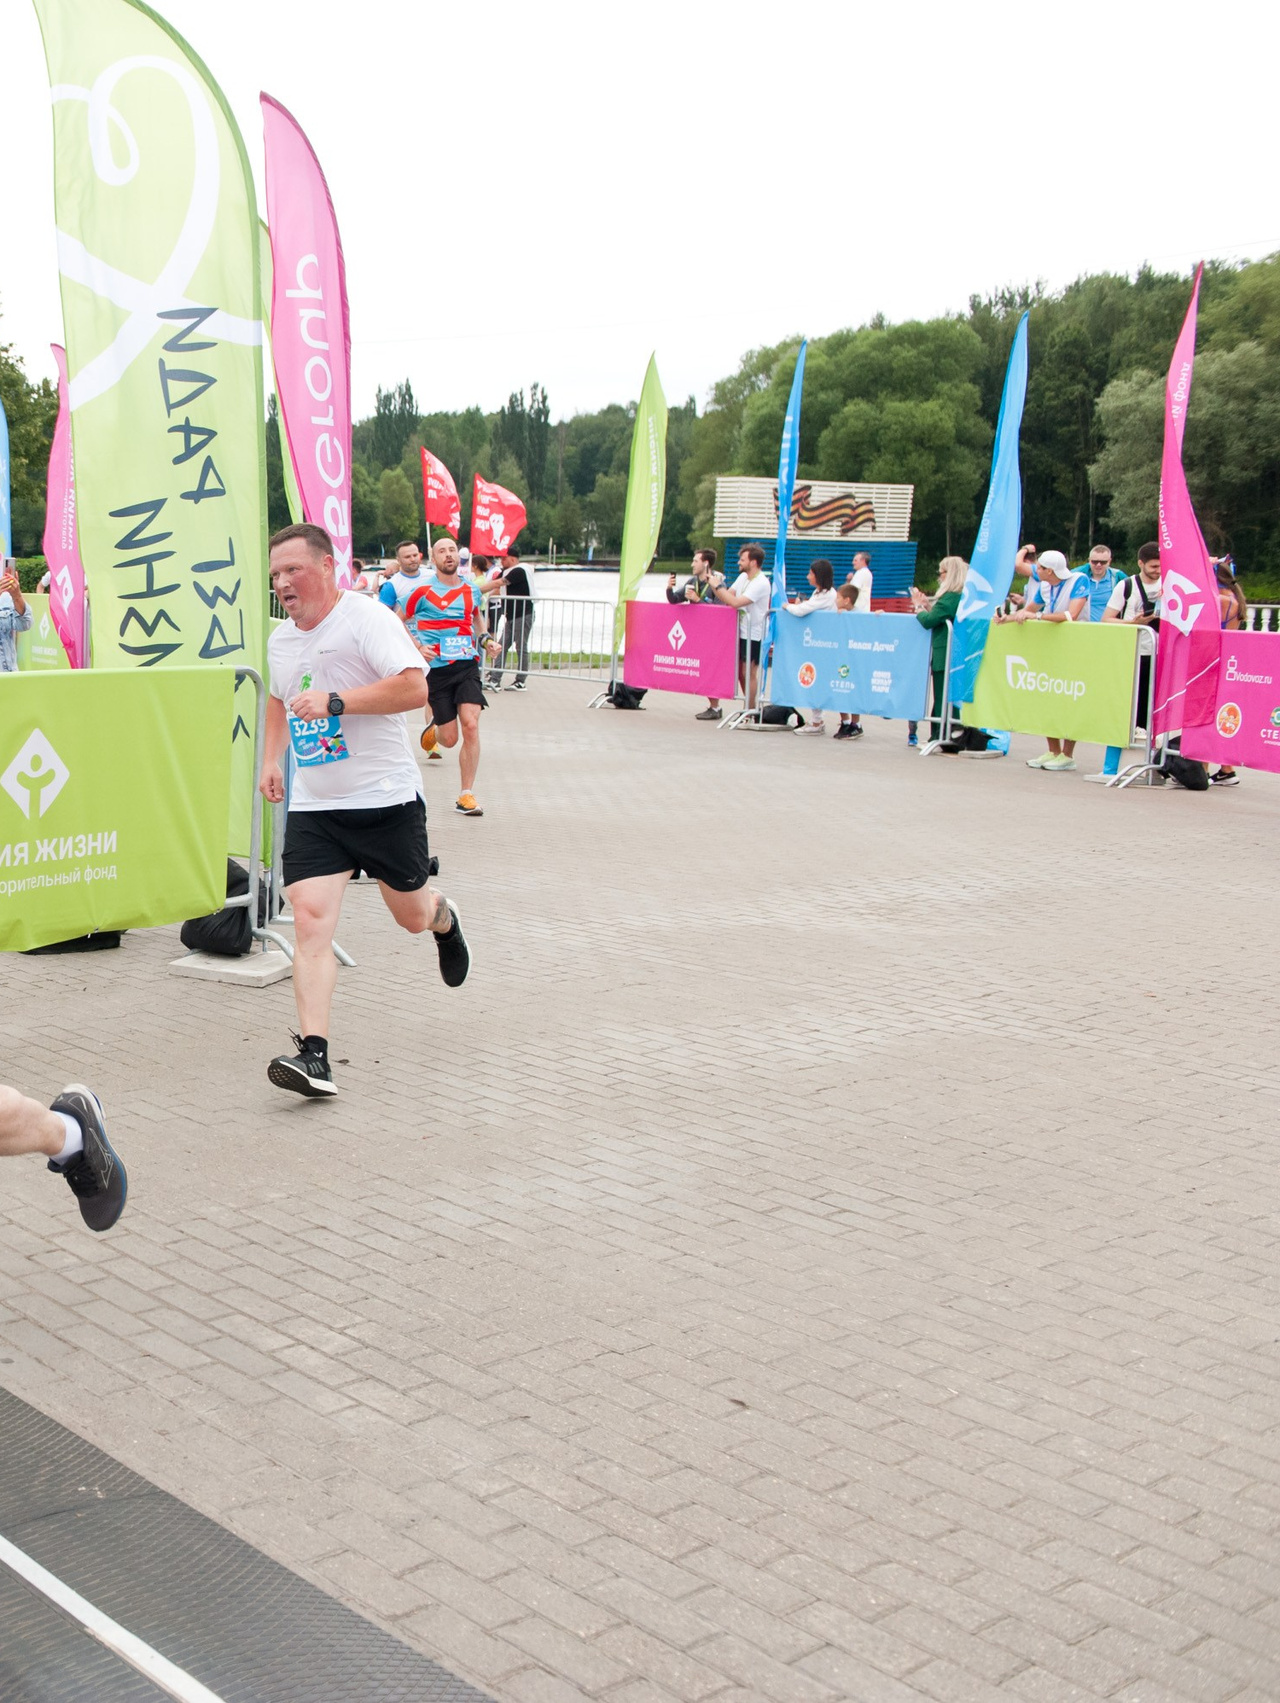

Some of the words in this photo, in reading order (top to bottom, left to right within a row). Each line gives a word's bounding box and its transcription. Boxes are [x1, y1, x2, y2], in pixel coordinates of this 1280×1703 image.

[445, 637, 469, 647] 3234
[653, 654, 675, 666] ЛИНИЯ
[675, 656, 700, 669] ЖИЗНИ
[829, 679, 856, 690] СТЕПЬ
[1235, 671, 1273, 685] Vodovoz.ru
[292, 718, 330, 738] 3239
[1260, 728, 1280, 740] СТЕ
[34, 830, 118, 864] ЖИЗНИ
[83, 864, 118, 885] фонд
